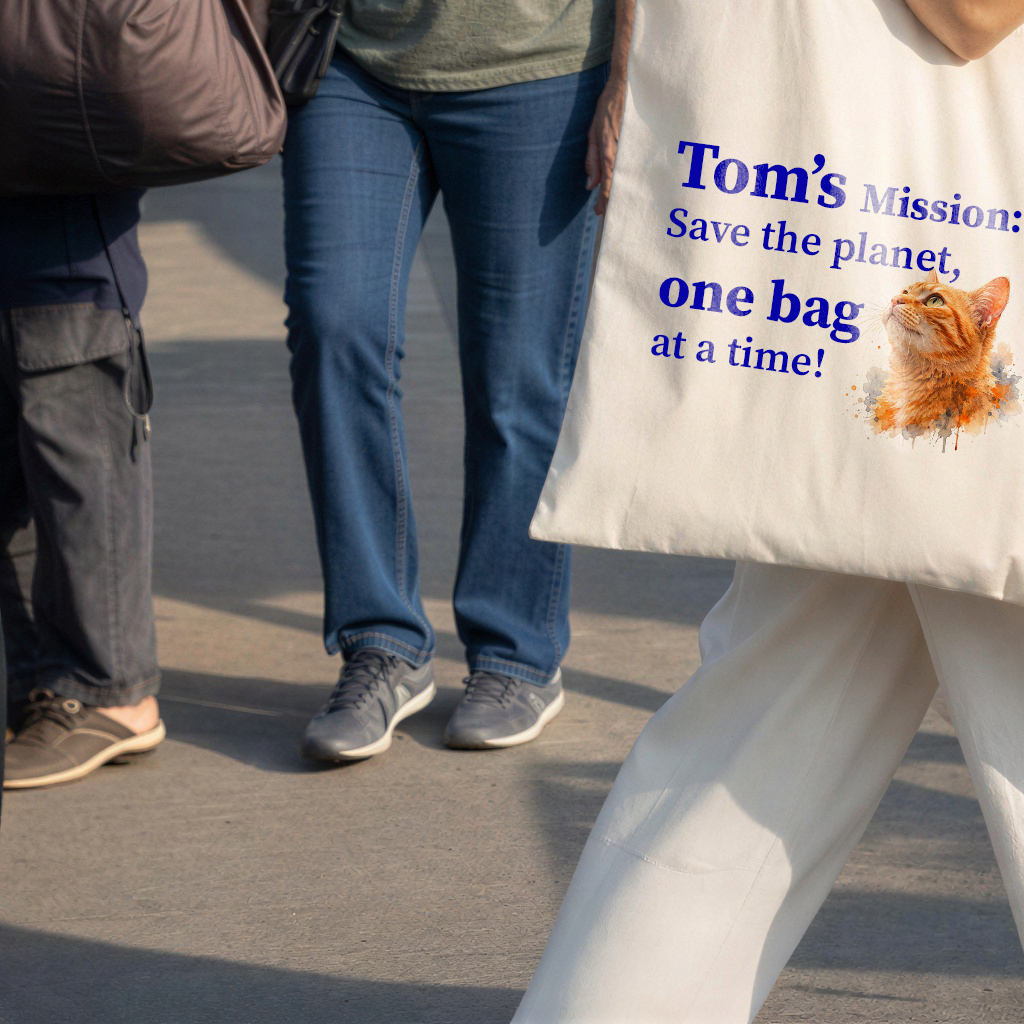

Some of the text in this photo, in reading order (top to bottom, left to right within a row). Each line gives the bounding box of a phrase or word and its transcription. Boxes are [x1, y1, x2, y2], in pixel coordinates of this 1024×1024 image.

[677, 140, 1023, 233] Tom’s Mission:
[666, 207, 961, 284] Save the planet,
[658, 276, 865, 344] one bag
[650, 331, 825, 379] at a time!
